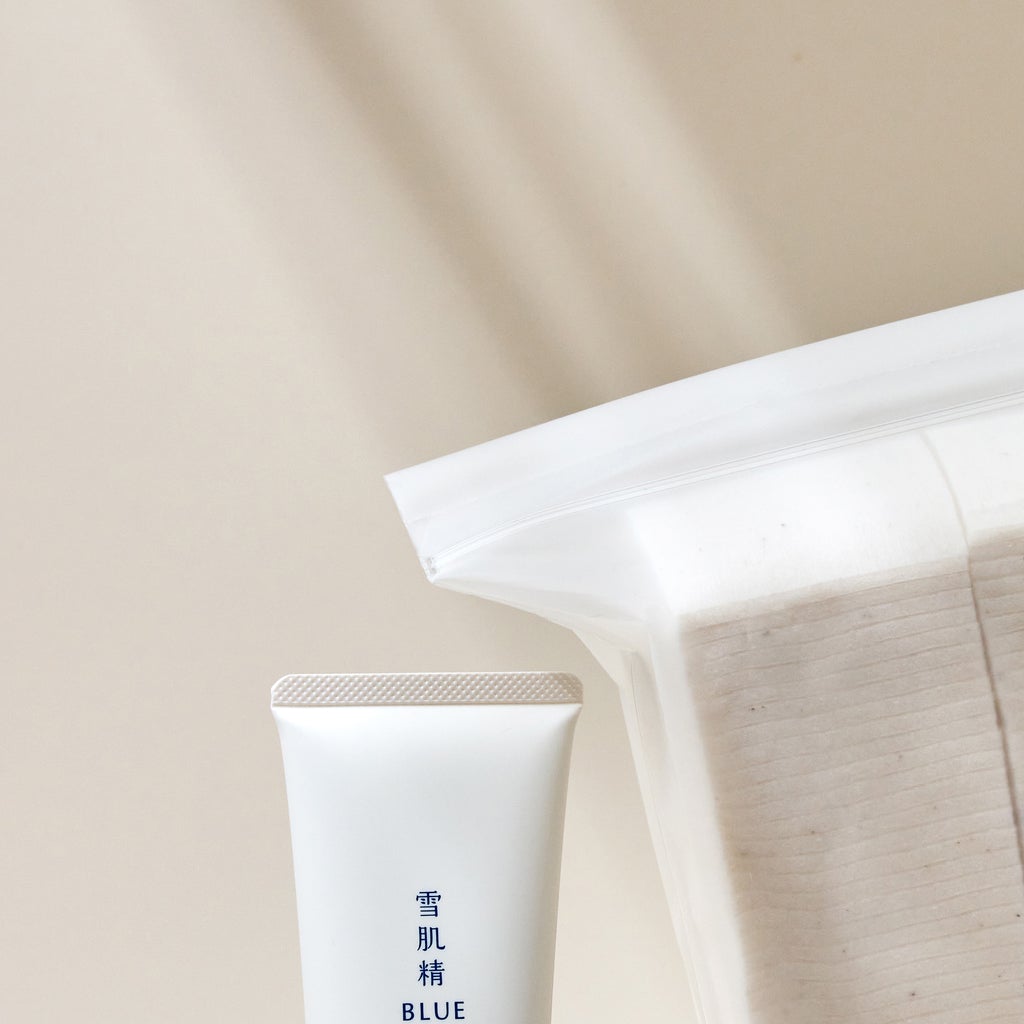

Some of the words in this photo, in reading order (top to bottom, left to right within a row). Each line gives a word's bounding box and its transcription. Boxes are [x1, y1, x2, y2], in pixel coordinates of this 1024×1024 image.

[415, 890, 446, 987] 雪肌精
[402, 1000, 465, 1021] BLUE
